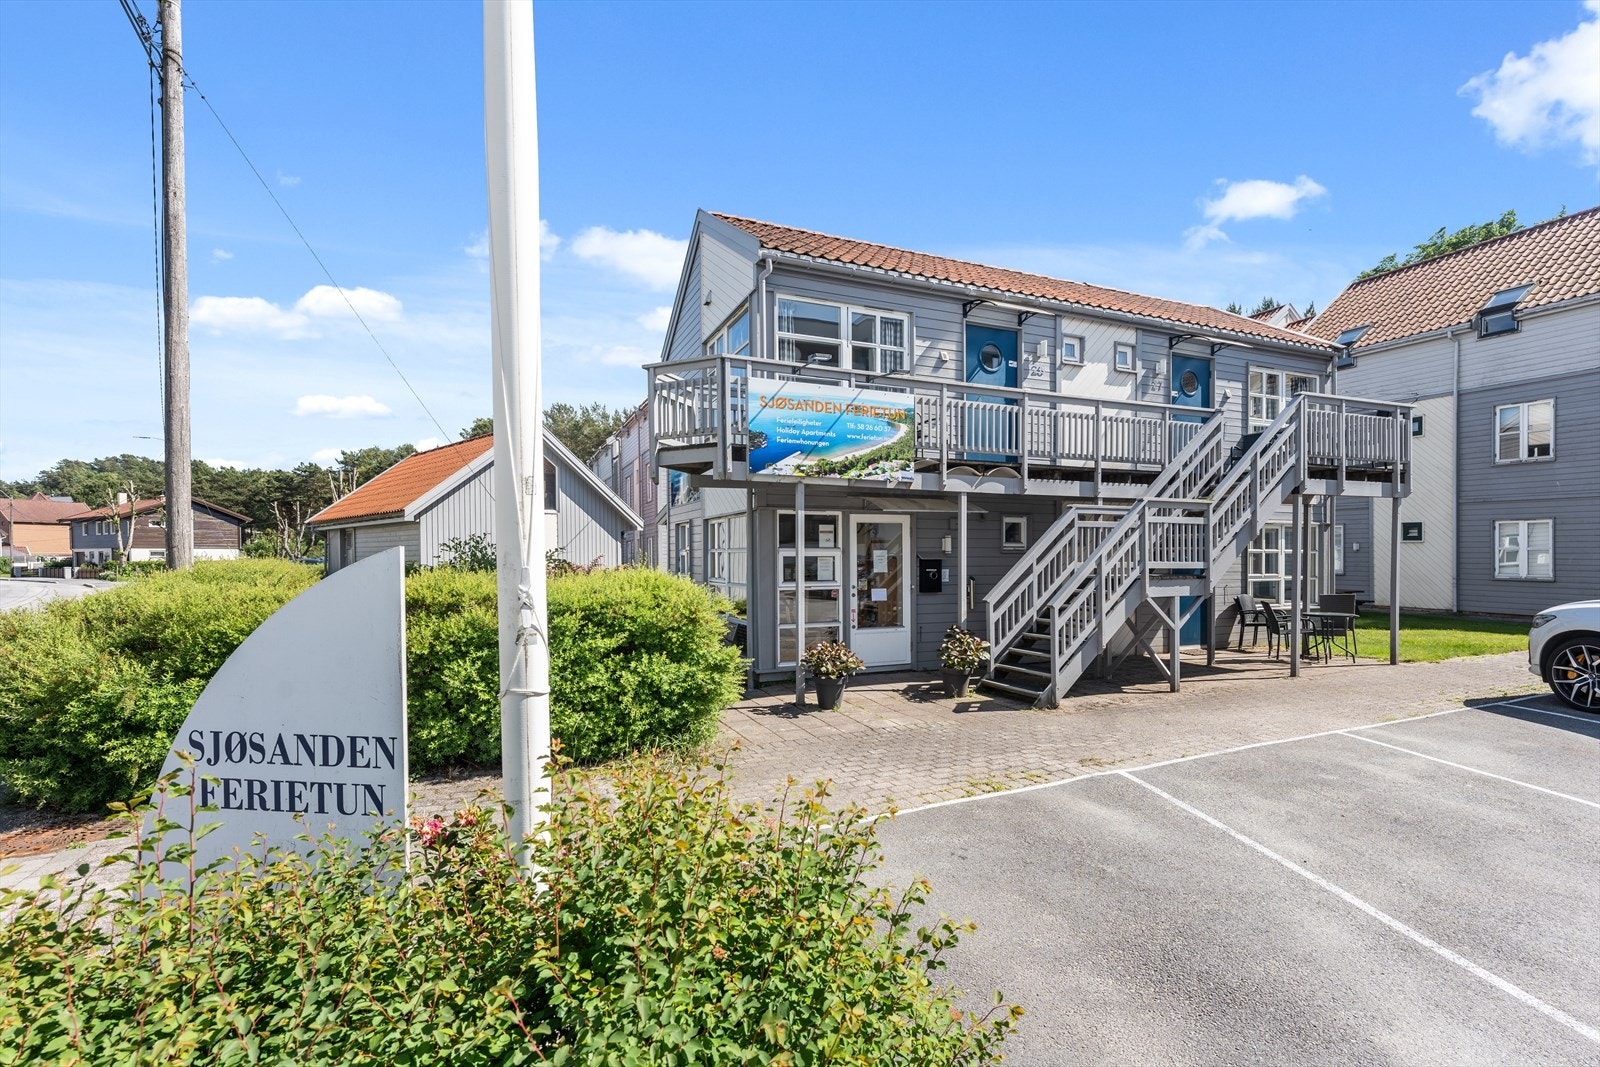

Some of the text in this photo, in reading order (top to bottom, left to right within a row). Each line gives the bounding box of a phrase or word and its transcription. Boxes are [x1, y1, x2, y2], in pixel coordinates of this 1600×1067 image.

[759, 394, 907, 420] SJØSANDEN FERIETUN
[776, 427, 837, 438] Holiday Apartments
[188, 729, 398, 770] SJØSANDEN
[199, 777, 386, 817] FERIETUN
